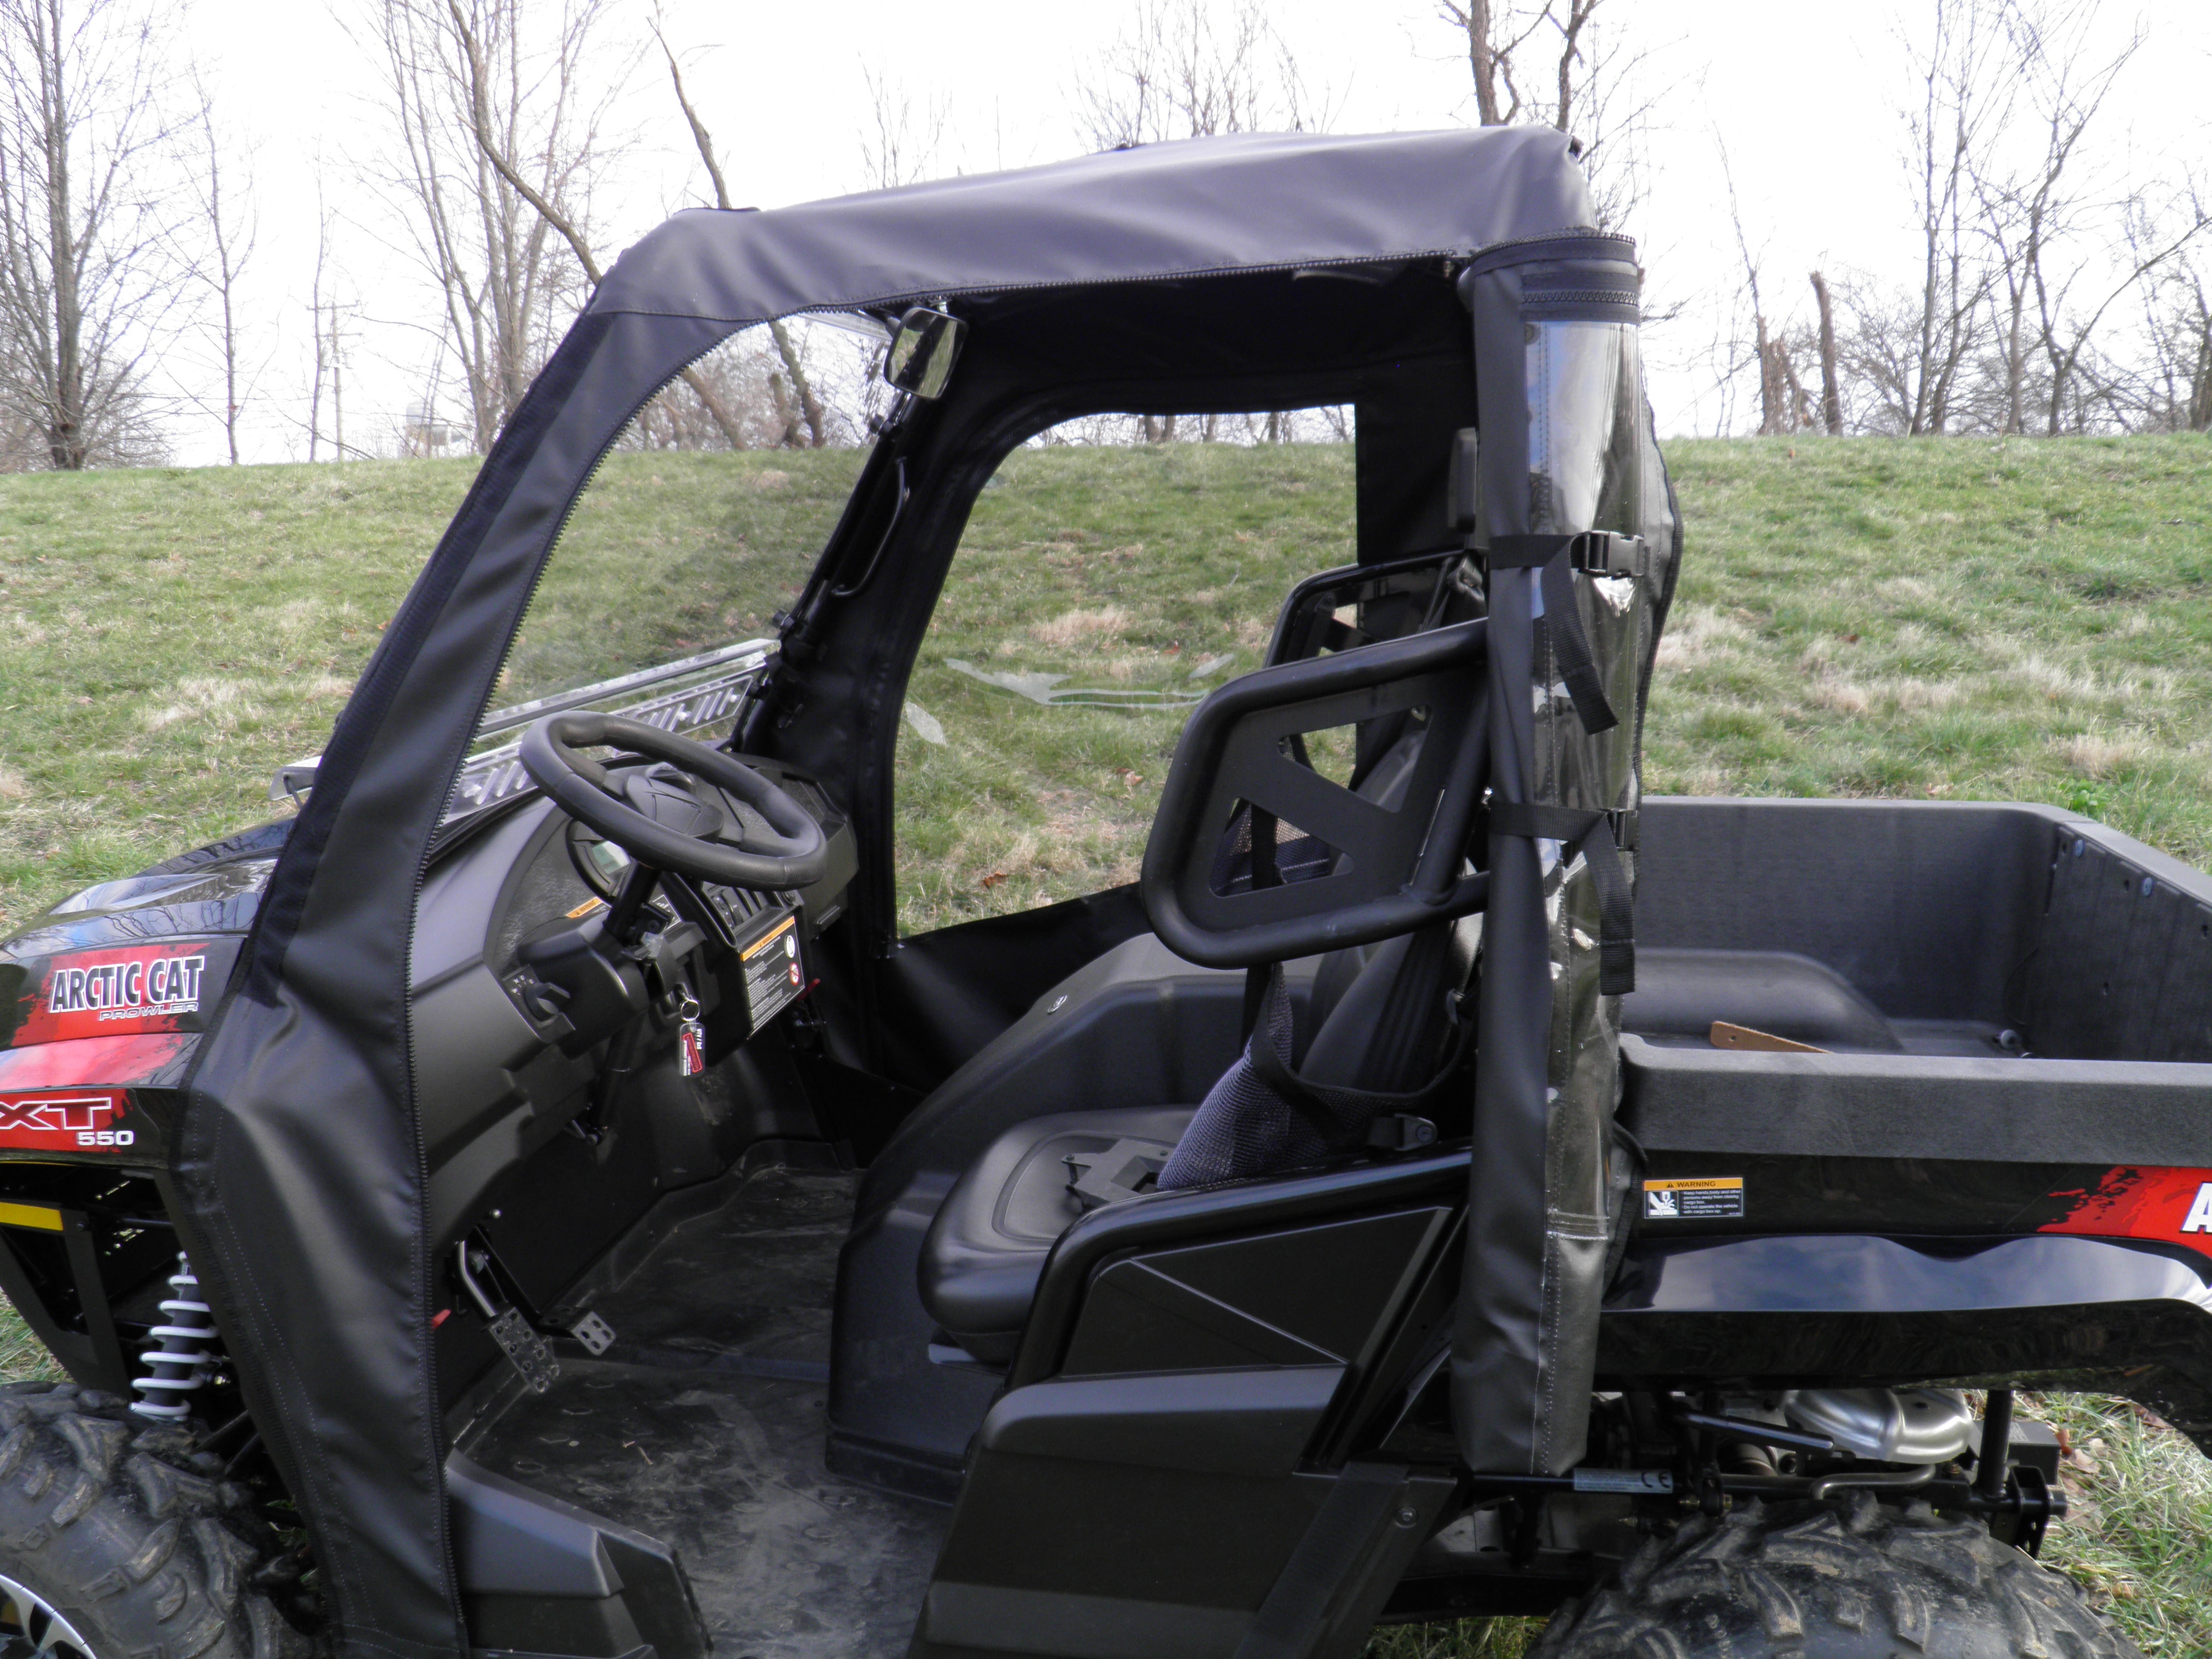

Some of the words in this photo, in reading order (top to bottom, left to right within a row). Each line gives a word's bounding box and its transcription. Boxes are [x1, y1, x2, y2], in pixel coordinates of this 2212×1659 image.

[50, 961, 142, 1013] ARCTIC
[147, 955, 205, 1004] CAT
[99, 1001, 199, 1021] PROWLER
[0, 1097, 112, 1131] XT
[77, 1131, 134, 1146] 550
